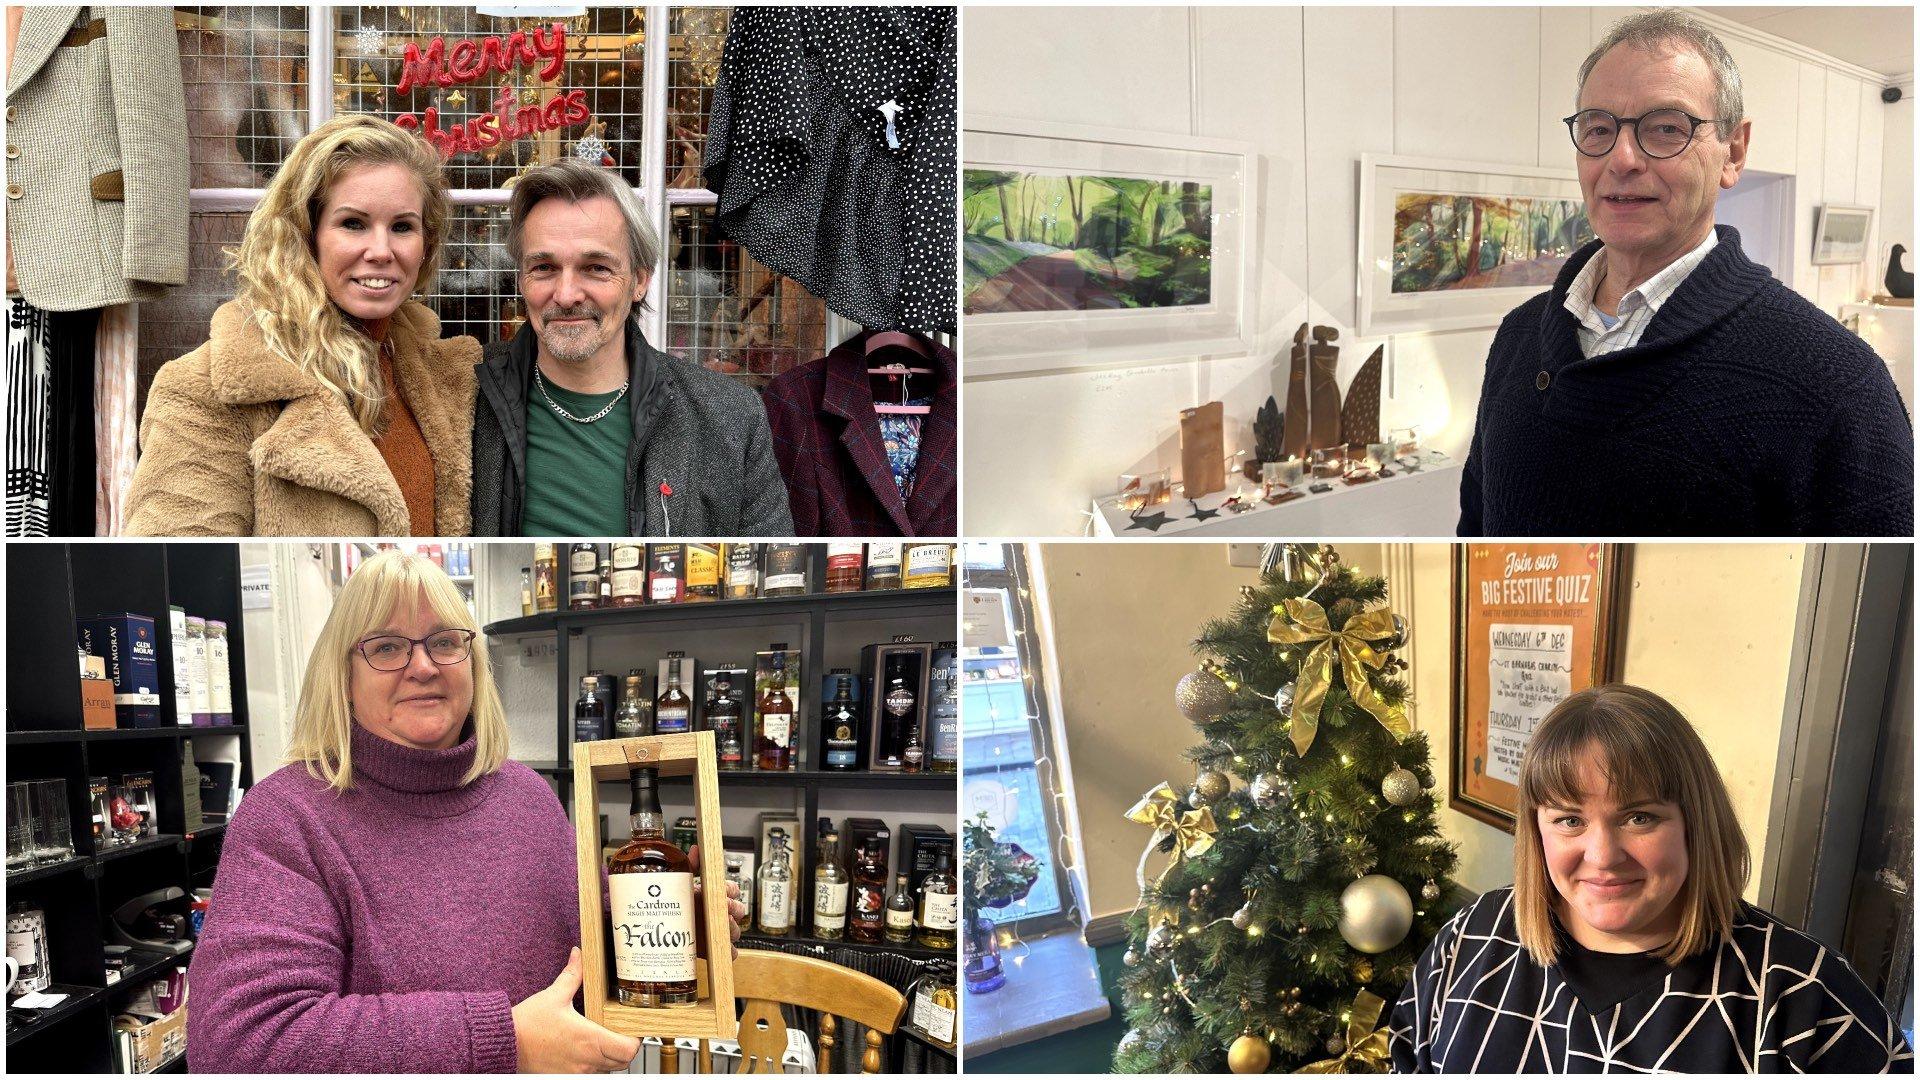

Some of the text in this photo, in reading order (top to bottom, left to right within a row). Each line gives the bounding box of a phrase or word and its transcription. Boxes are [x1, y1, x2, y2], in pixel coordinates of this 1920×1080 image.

[396, 22, 566, 95] Merry
[690, 566, 714, 574] CLASSIC
[1504, 552, 1559, 579] Join our
[1481, 574, 1592, 606] BIG FESTIVE QUIZ
[110, 626, 118, 662] MORAY
[135, 641, 151, 649] GLEN
[1493, 631, 1531, 648] WEDNESDAY
[1551, 632, 1565, 650] DEC
[133, 646, 154, 656] MORAY
[214, 649, 222, 657] 16
[84, 697, 111, 709] Arran
[1490, 711, 1521, 730] THURSDAY
[1502, 736, 1521, 749] FESTIVE
[636, 900, 681, 910] Cardrona
[614, 922, 695, 948] Falcon
